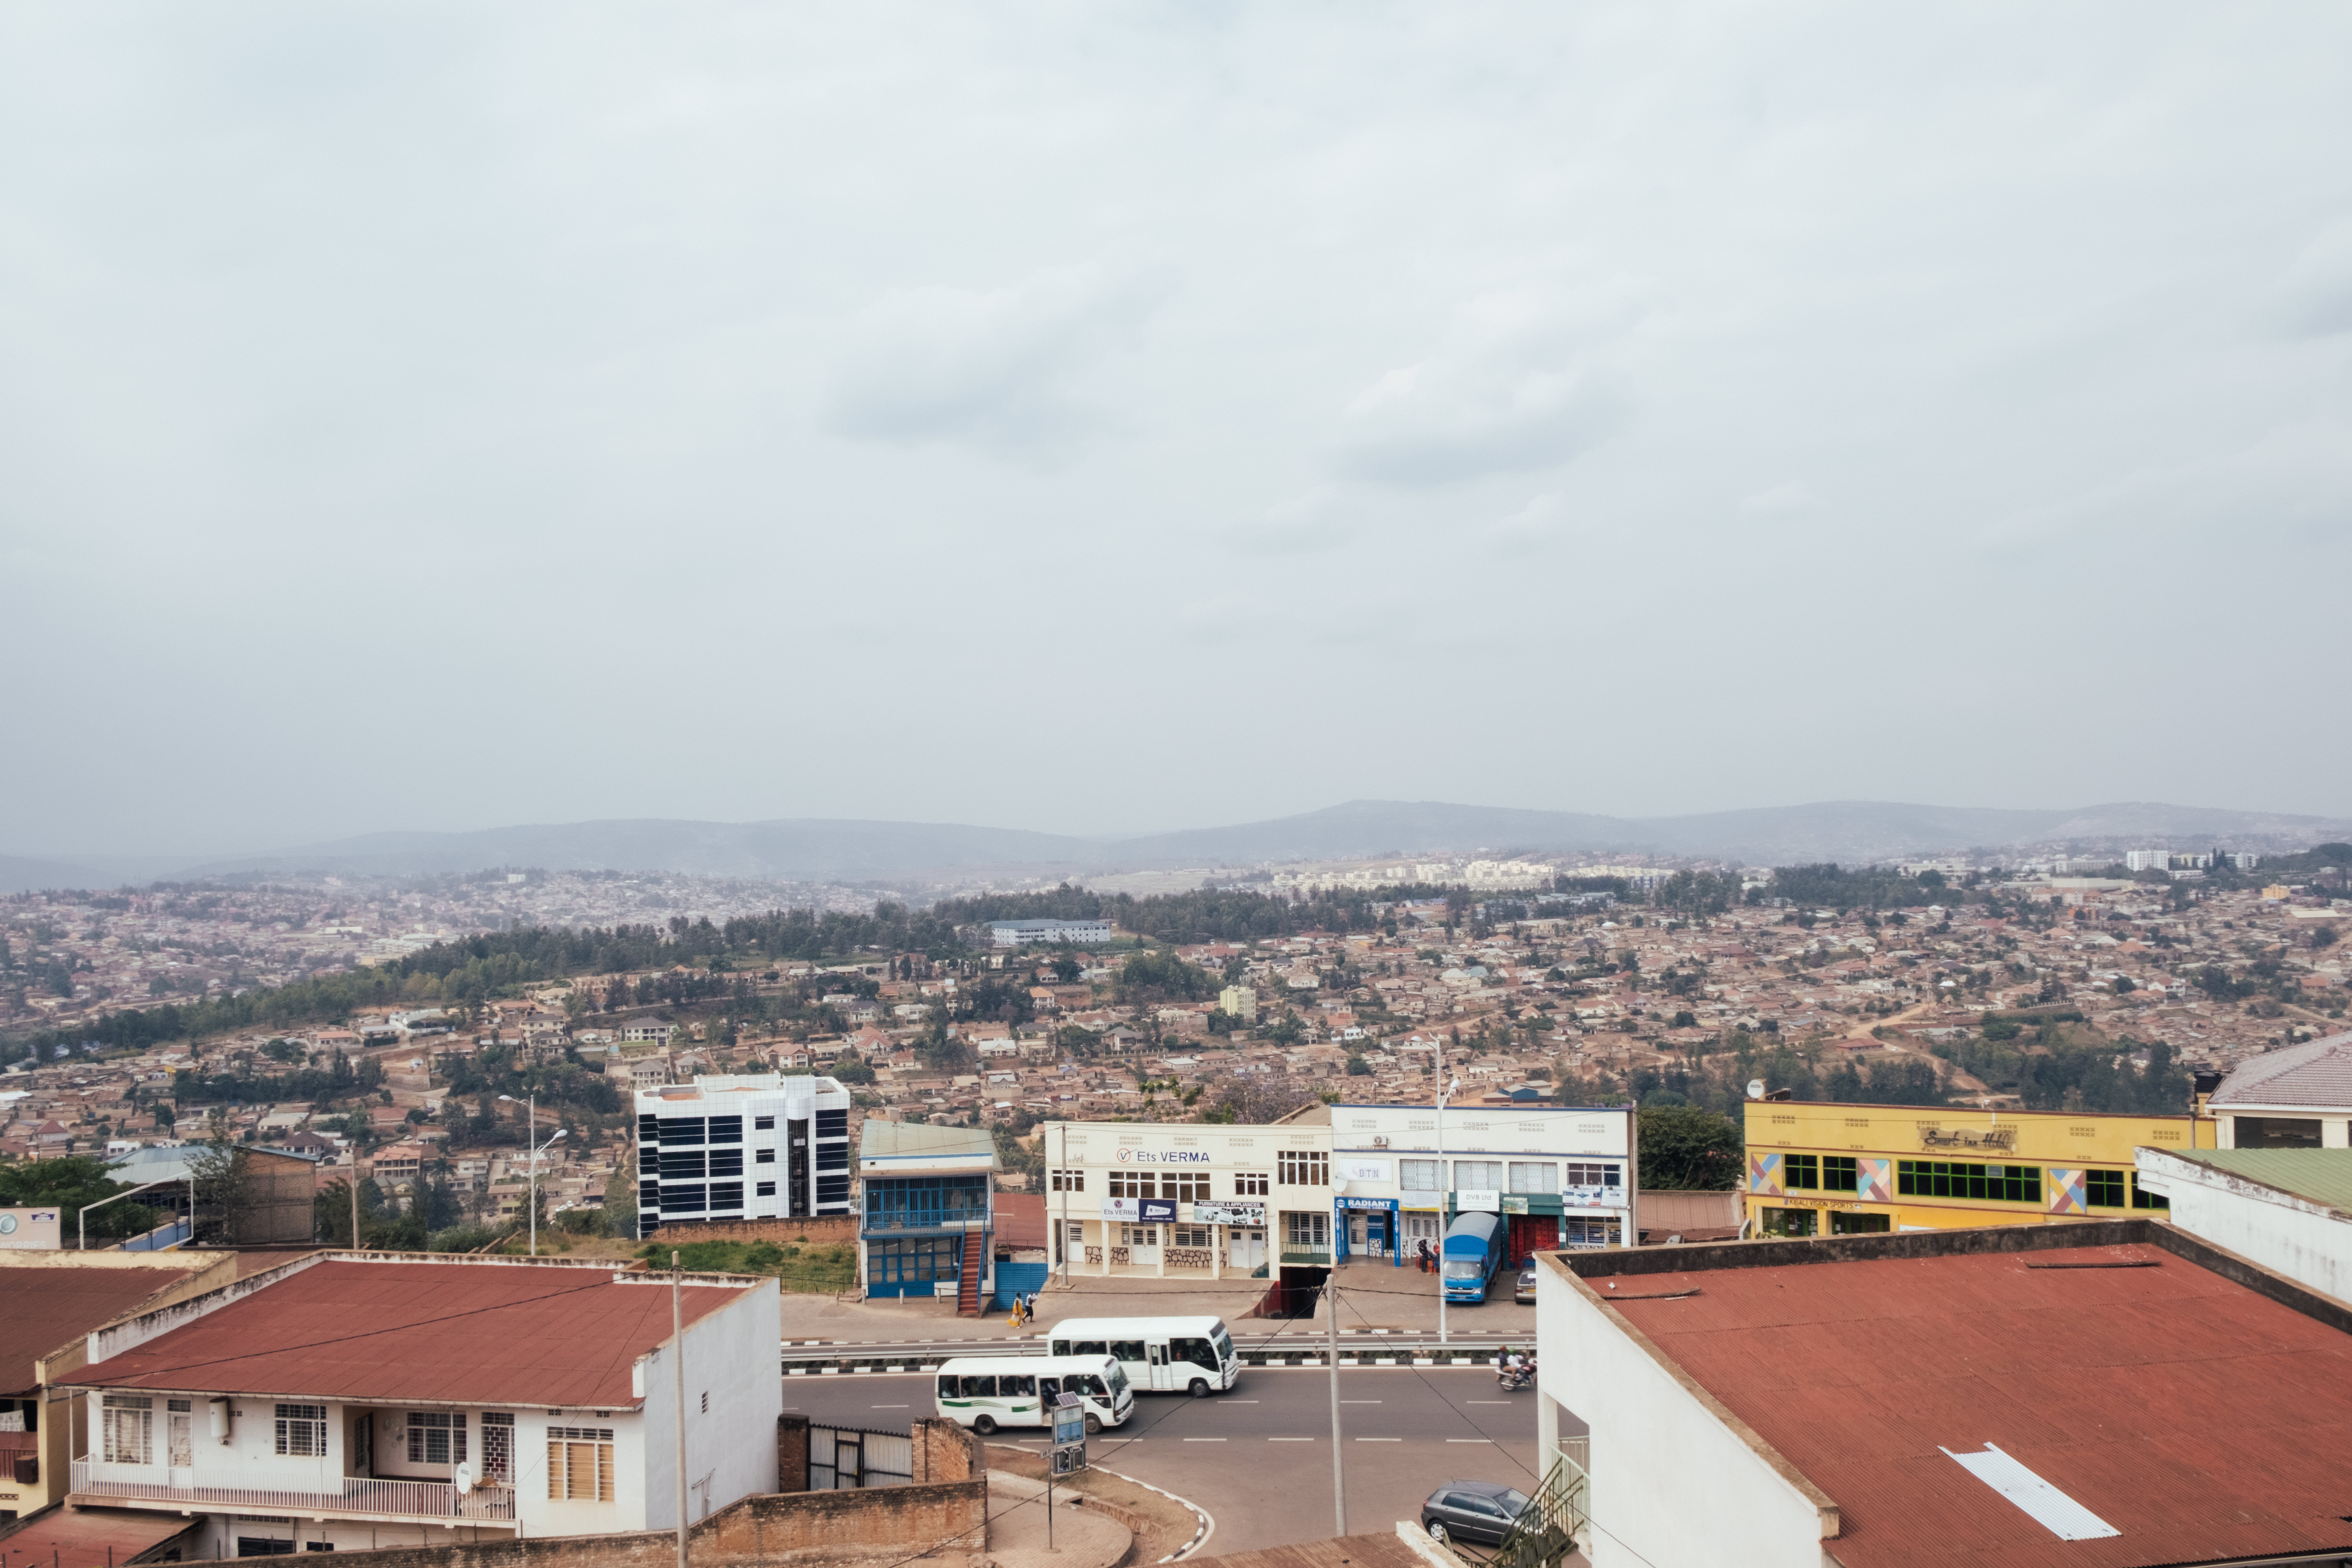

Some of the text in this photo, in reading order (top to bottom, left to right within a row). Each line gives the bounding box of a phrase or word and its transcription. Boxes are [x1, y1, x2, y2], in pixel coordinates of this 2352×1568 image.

[1138, 1151, 1156, 1161] Ets
[1160, 1152, 1210, 1162] VERMA
[1359, 1169, 1379, 1178] BTN
